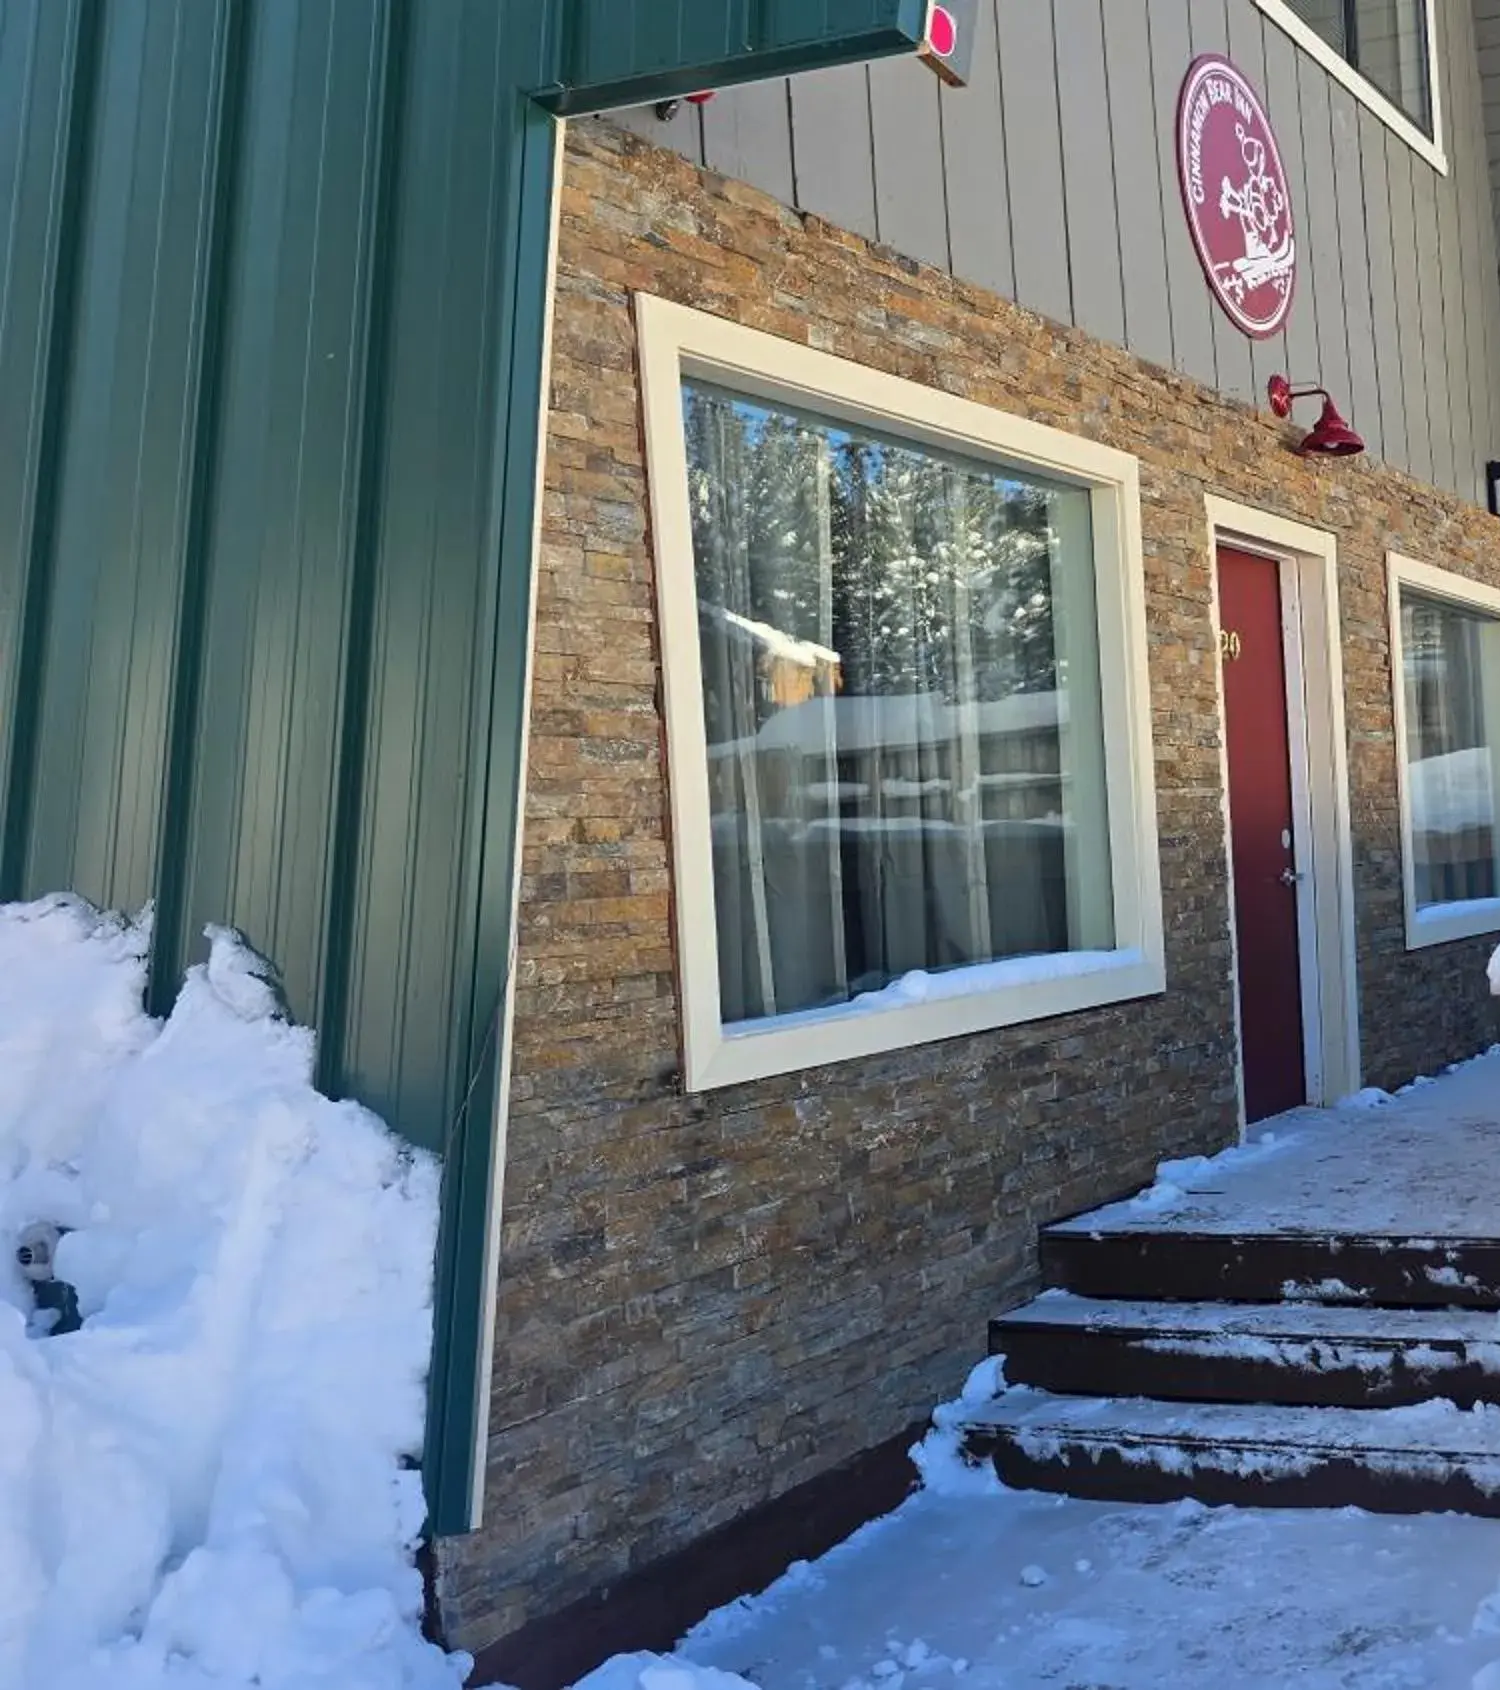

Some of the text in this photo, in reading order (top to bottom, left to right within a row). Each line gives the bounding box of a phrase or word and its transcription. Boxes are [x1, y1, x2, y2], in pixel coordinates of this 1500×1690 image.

[1190, 79, 1253, 204] CINNAMON BEAR INN
